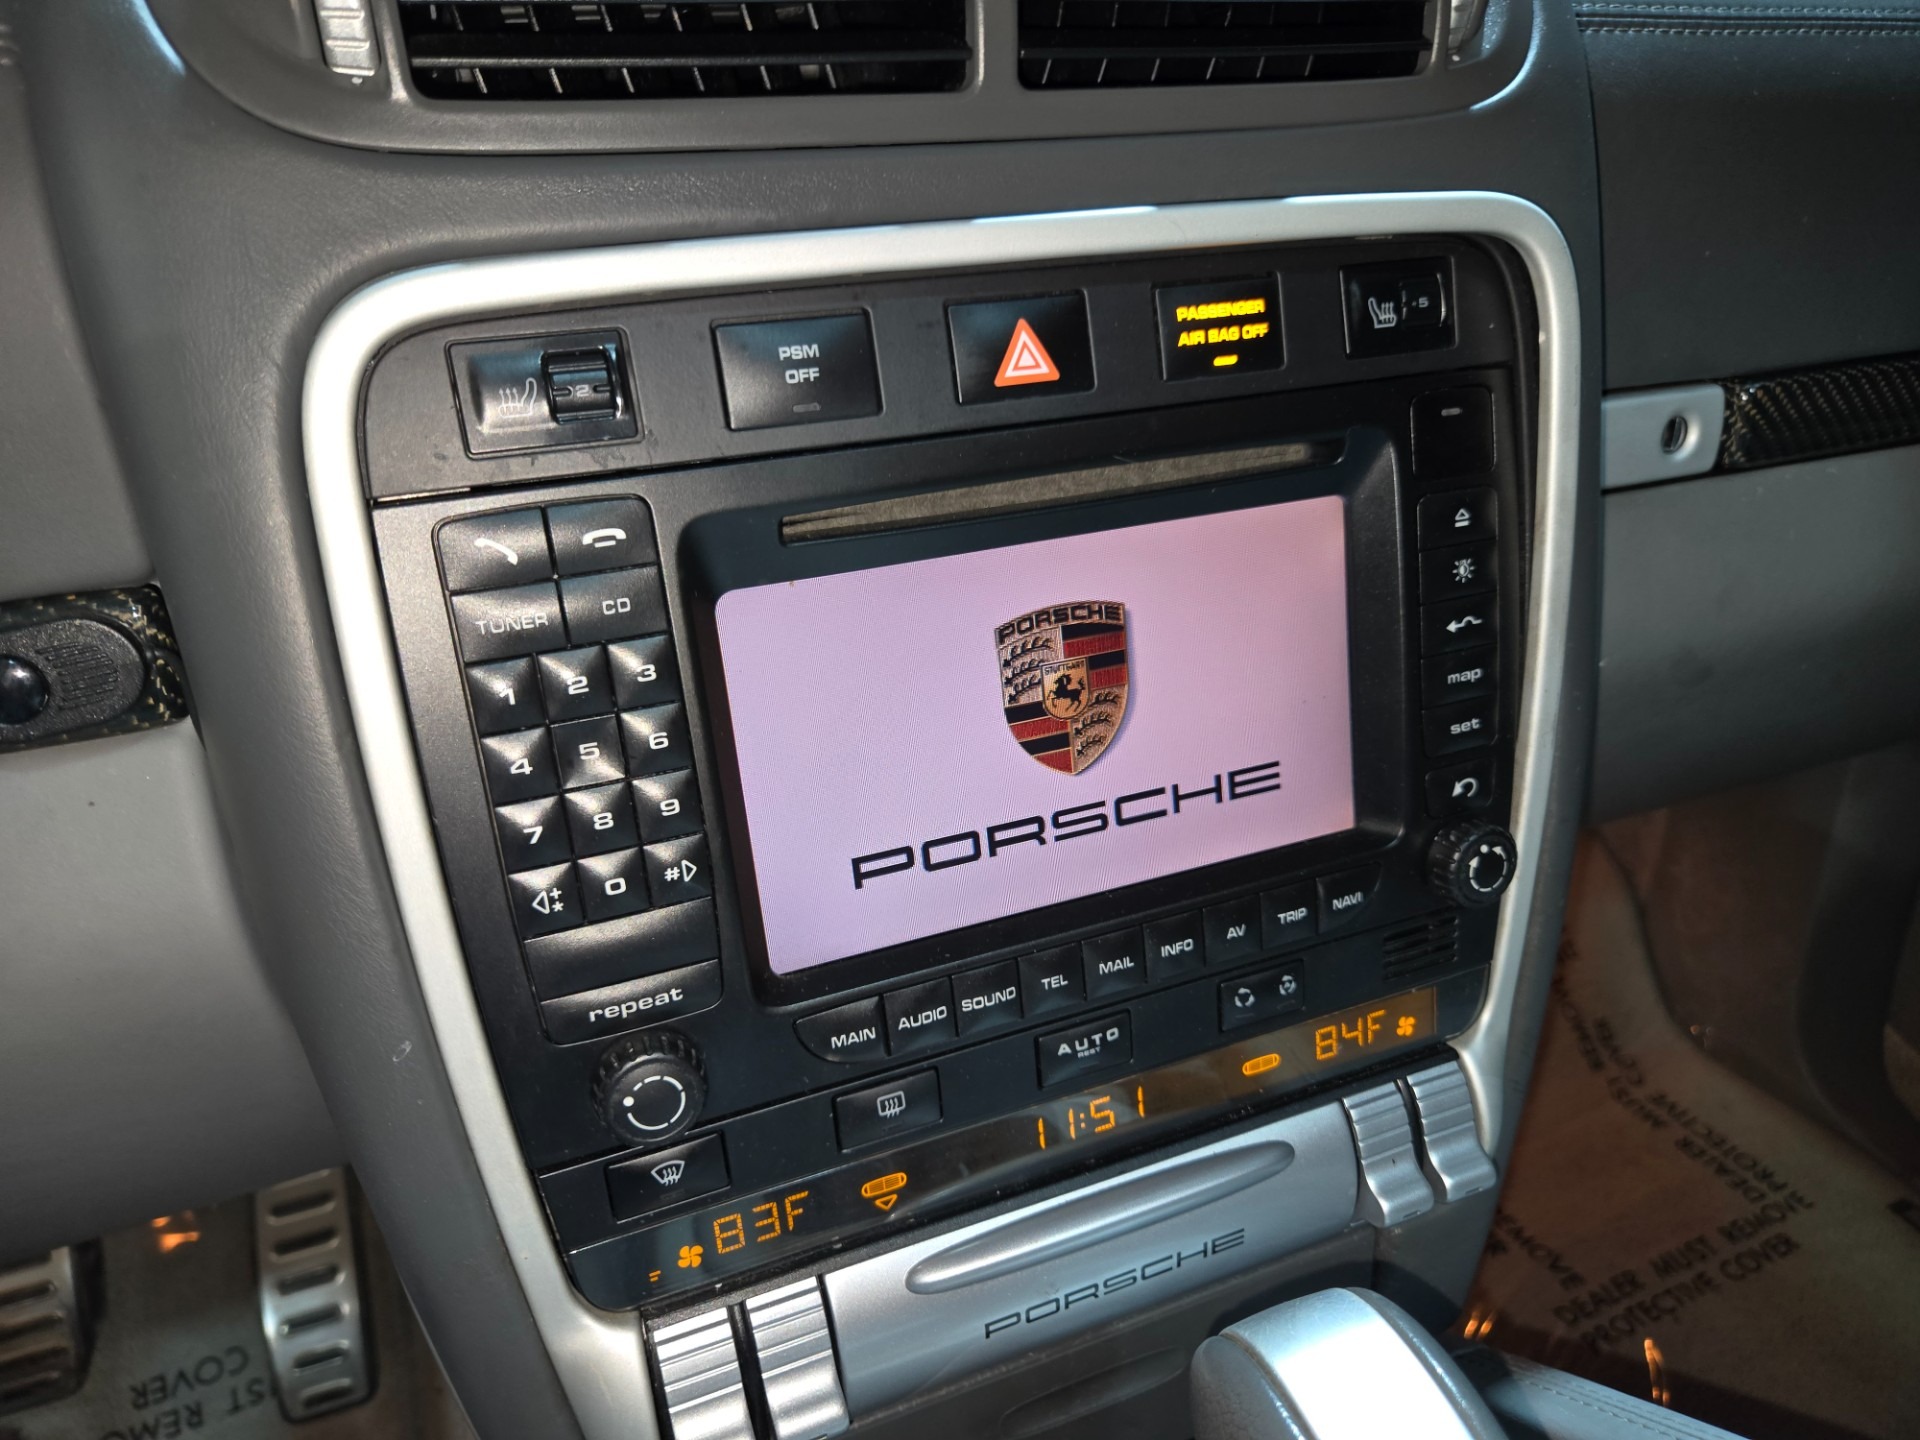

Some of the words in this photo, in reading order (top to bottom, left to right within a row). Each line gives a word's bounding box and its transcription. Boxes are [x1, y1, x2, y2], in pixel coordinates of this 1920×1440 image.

[1175, 298, 1266, 322] PASSENGER
[1177, 329, 1206, 347] AIR
[1208, 325, 1240, 343] BAG
[1242, 322, 1269, 339] OFF
[778, 343, 820, 361] PSM
[784, 366, 820, 384] OFF
[602, 597, 631, 616] CD
[475, 612, 549, 635] TUNER
[999, 602, 1121, 646] PORSCHE
[636, 664, 657, 683] 3
[1447, 667, 1483, 685] map
[566, 676, 590, 695] 2
[499, 687, 516, 705] 1
[1450, 717, 1481, 735] set
[649, 731, 669, 750] 6
[579, 742, 600, 760] 5
[510, 758, 534, 775] 4
[660, 798, 680, 816] 9
[593, 812, 614, 830] 8
[851, 760, 1282, 891] PORSCHE
[523, 825, 544, 844] 7
[1332, 891, 1363, 911] NAVI
[1277, 907, 1308, 925] TRIP
[1226, 924, 1246, 940] AV
[1160, 938, 1194, 958] INFO
[1098, 956, 1135, 975] MAIL
[1041, 974, 1068, 991] TEL
[588, 987, 684, 1022] repeat
[961, 986, 1017, 1012] SOUND
[897, 1005, 948, 1031] AUDIO
[830, 1027, 877, 1049] MAIN
[1057, 1026, 1120, 1057] AUTO
[1315, 1009, 1386, 1060] 84F
[1077, 1046, 1101, 1059] REST
[1037, 1086, 1145, 1150] 11:51
[712, 1190, 809, 1254] 83F
[1552, 1268, 1646, 1328] DEALER
[1648, 1234, 1717, 1281] MUST
[1716, 1191, 1814, 1244] REMOVE
[984, 1228, 1245, 1339] PORSCHE
[1581, 1270, 1719, 1355] PROTECTIVE
[1720, 1232, 1800, 1283] COVER
[129, 1345, 250, 1412] COVER
[226, 1377, 268, 1417] ST
